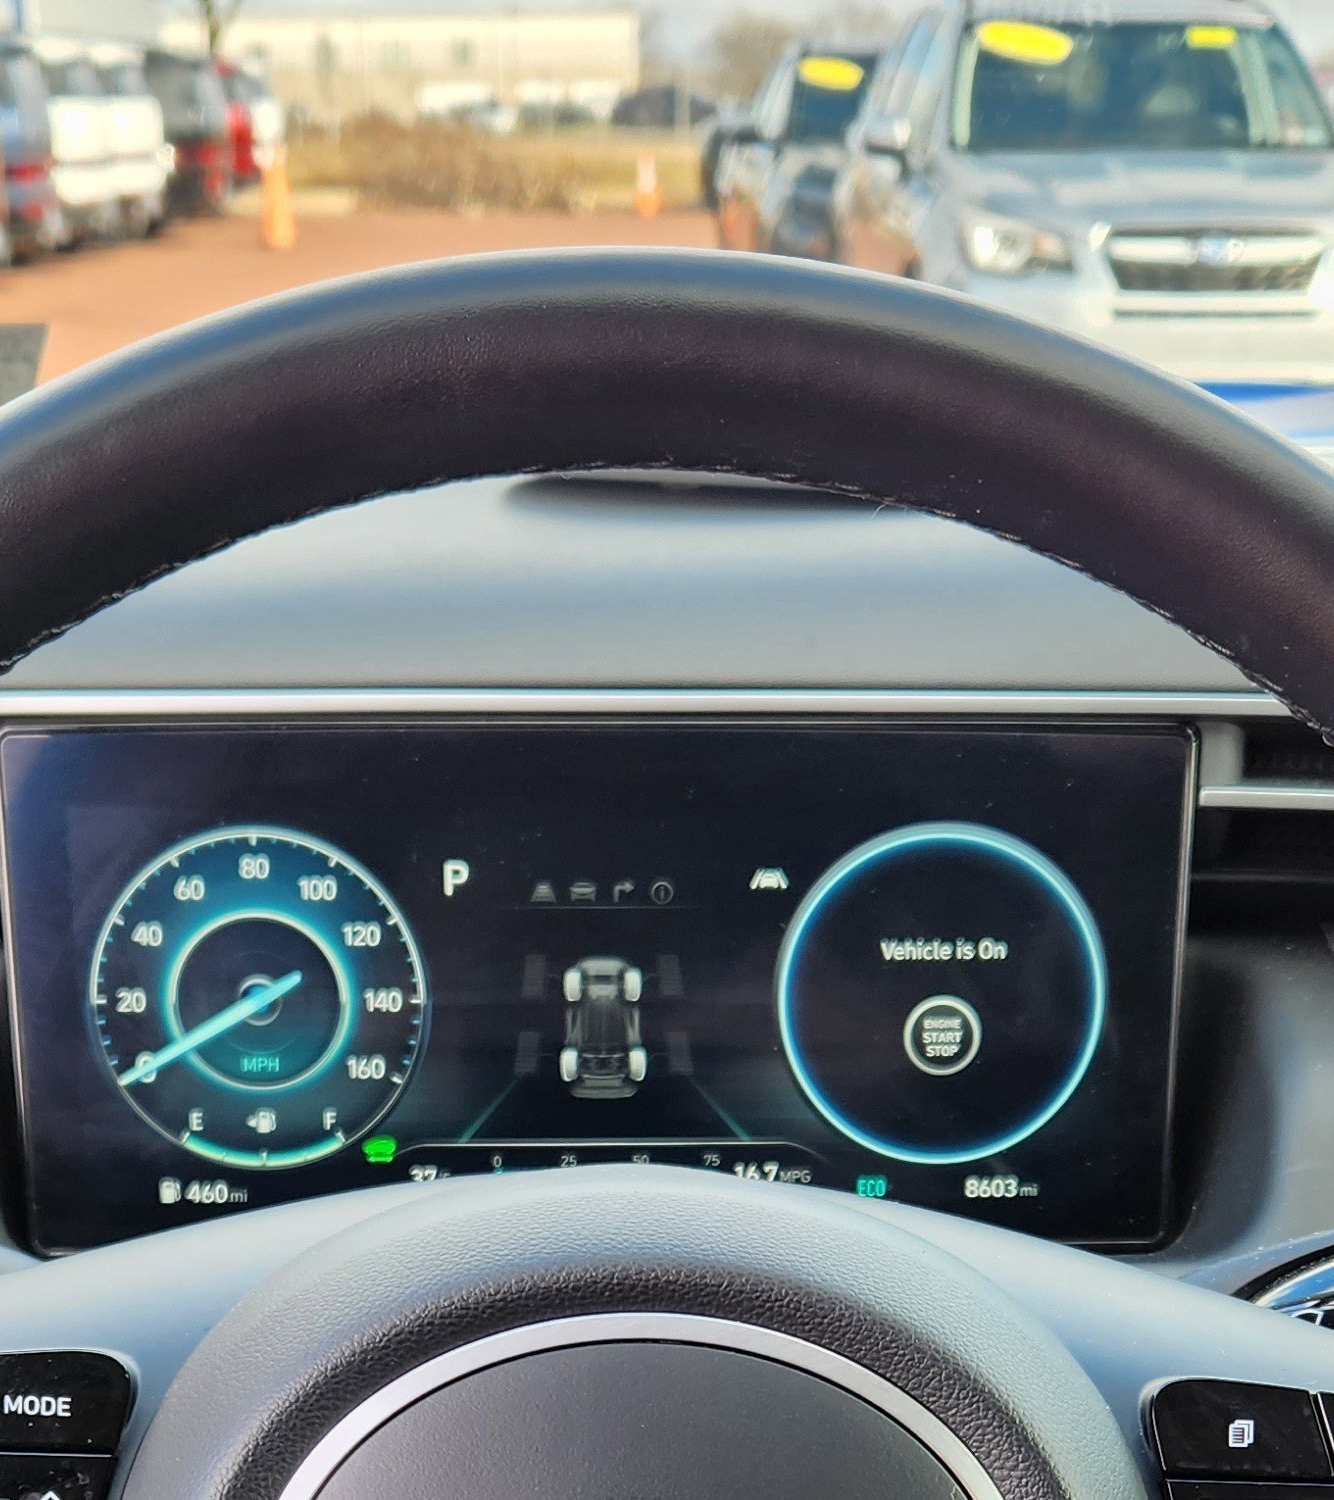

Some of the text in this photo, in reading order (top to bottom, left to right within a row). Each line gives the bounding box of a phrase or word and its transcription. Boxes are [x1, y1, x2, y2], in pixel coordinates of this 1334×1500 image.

[238, 855, 270, 880] 80
[441, 860, 469, 896] P
[173, 877, 205, 901] 60
[298, 877, 337, 901] 100
[131, 923, 163, 948] 40
[342, 923, 381, 948] 120
[880, 940, 1008, 963] Vehicle is On
[115, 991, 147, 1014] 20
[364, 989, 403, 1013] 140
[922, 1031, 963, 1044] START
[926, 1045, 961, 1057] STOP
[242, 1057, 280, 1073] MPH
[347, 1055, 386, 1080] 160
[189, 1110, 205, 1132] E
[322, 1111, 338, 1131] F
[492, 1154, 503, 1167] 0
[560, 1154, 577, 1168] 25
[633, 1154, 650, 1164] 50
[703, 1154, 720, 1167] 75
[733, 1161, 812, 1183] 167 MPG
[186, 1180, 247, 1204] 460 mi
[858, 1179, 886, 1196] ECO
[964, 1178, 1038, 1198] 8603 mi
[3, 1395, 71, 1418] MODE
